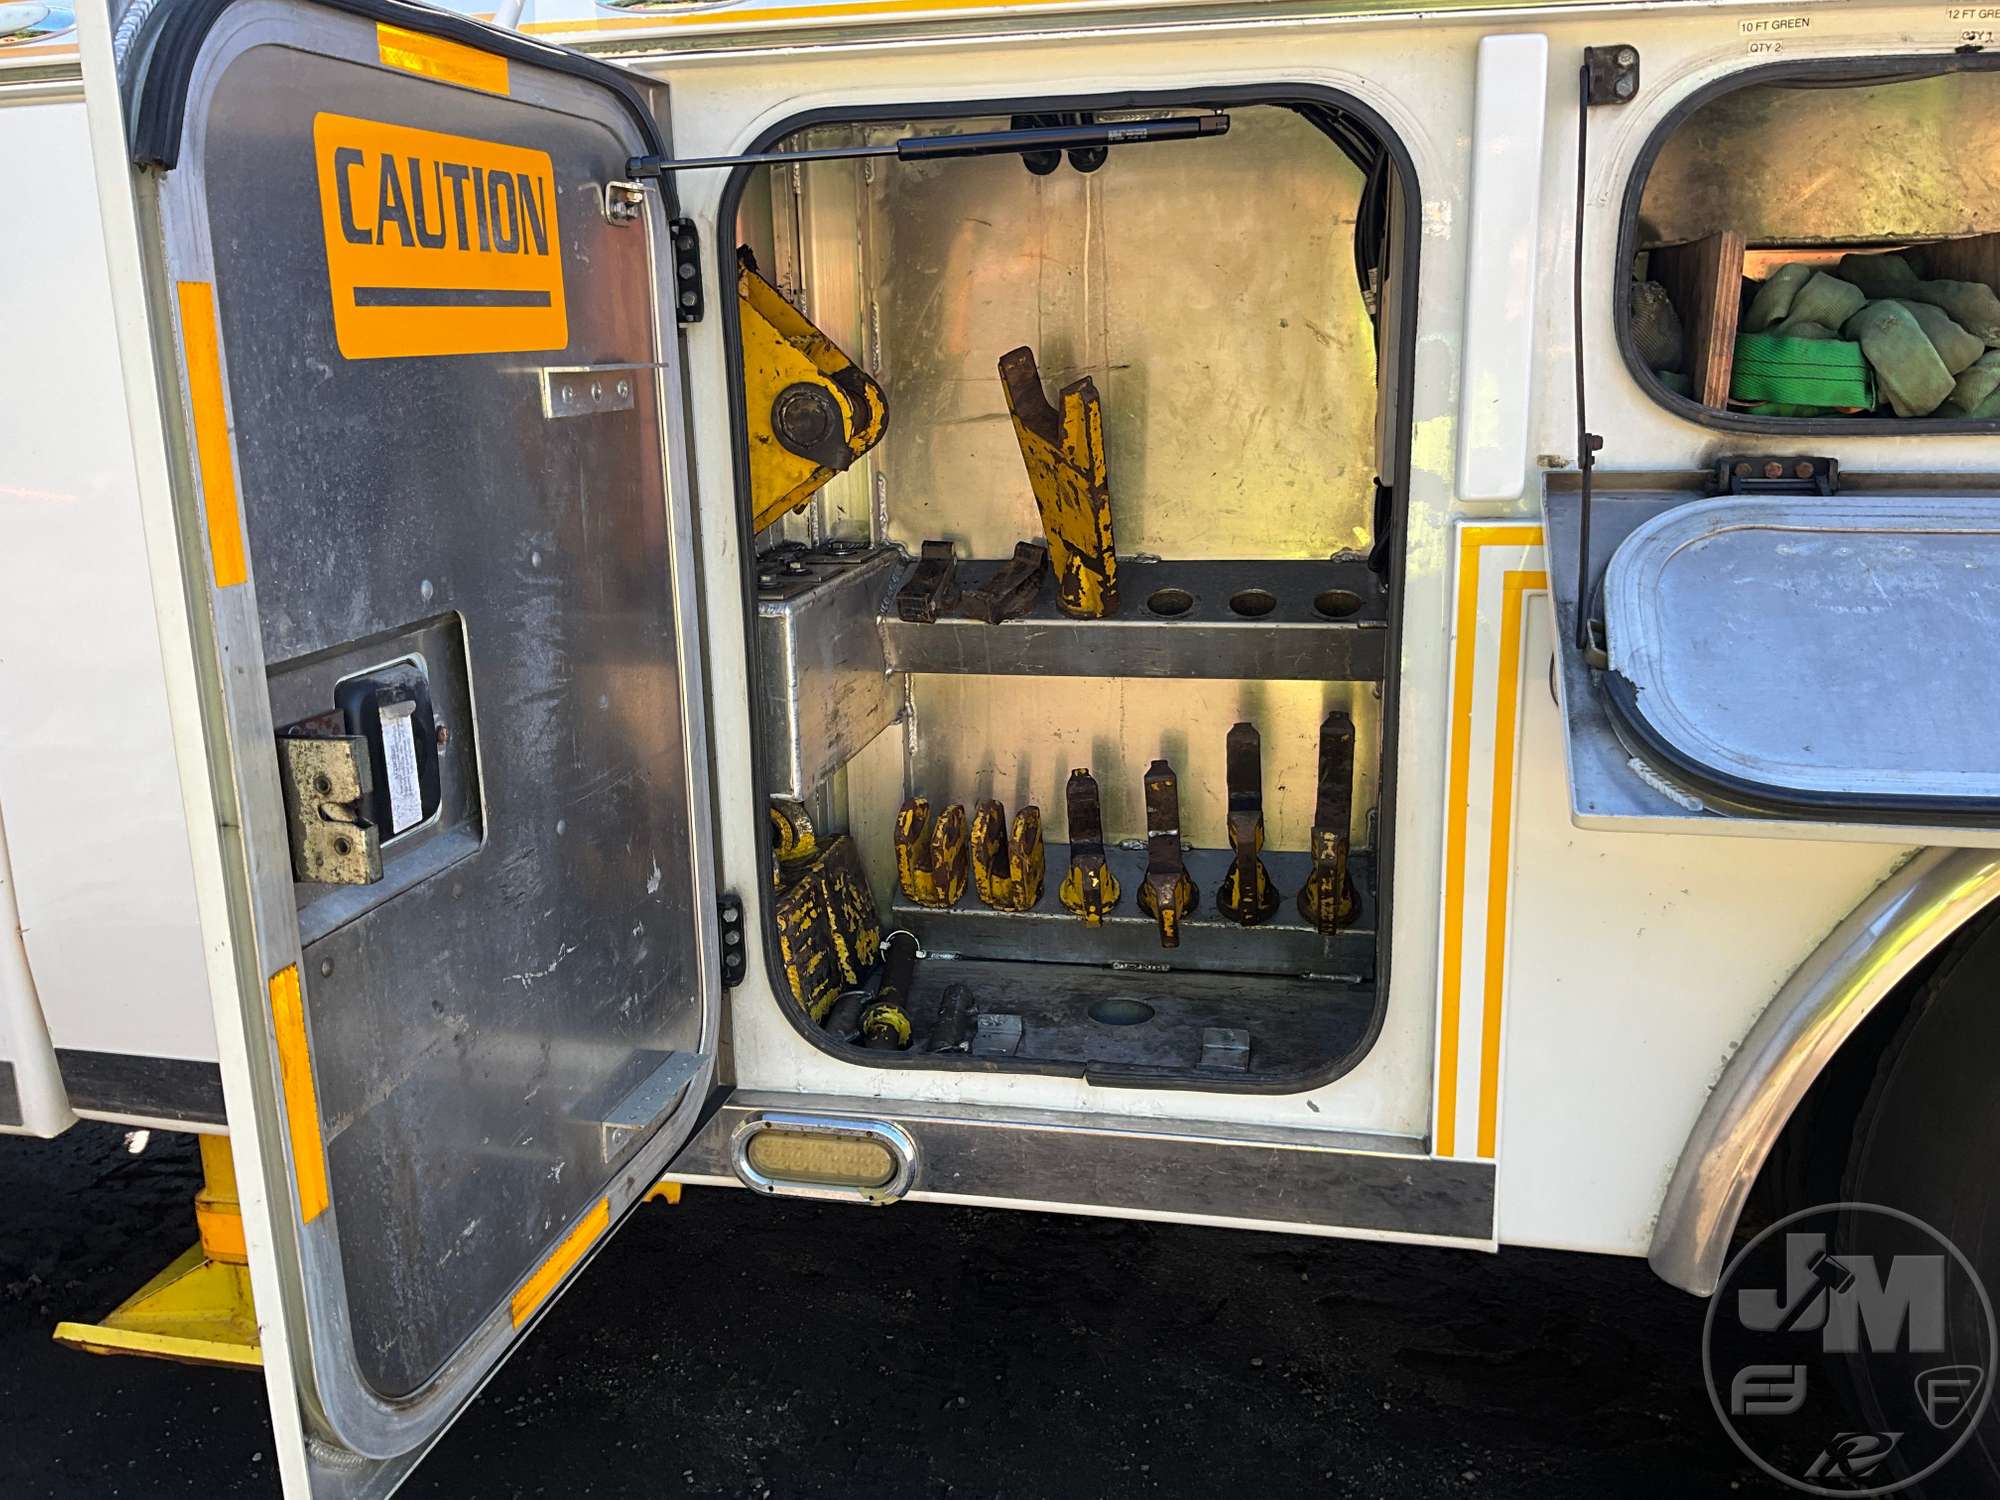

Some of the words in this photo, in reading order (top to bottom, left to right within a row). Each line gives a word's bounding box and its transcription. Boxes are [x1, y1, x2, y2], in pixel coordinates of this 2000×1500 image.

[1948, 9, 1960, 19] 12
[1962, 9, 1976, 19] FT
[1742, 22, 1754, 32] 10
[1755, 21, 1769, 31] FT
[1771, 17, 1810, 30] GREEN
[1750, 43, 1772, 53] QTY
[1774, 42, 1782, 52] 2
[334, 146, 549, 256] CAUTION
